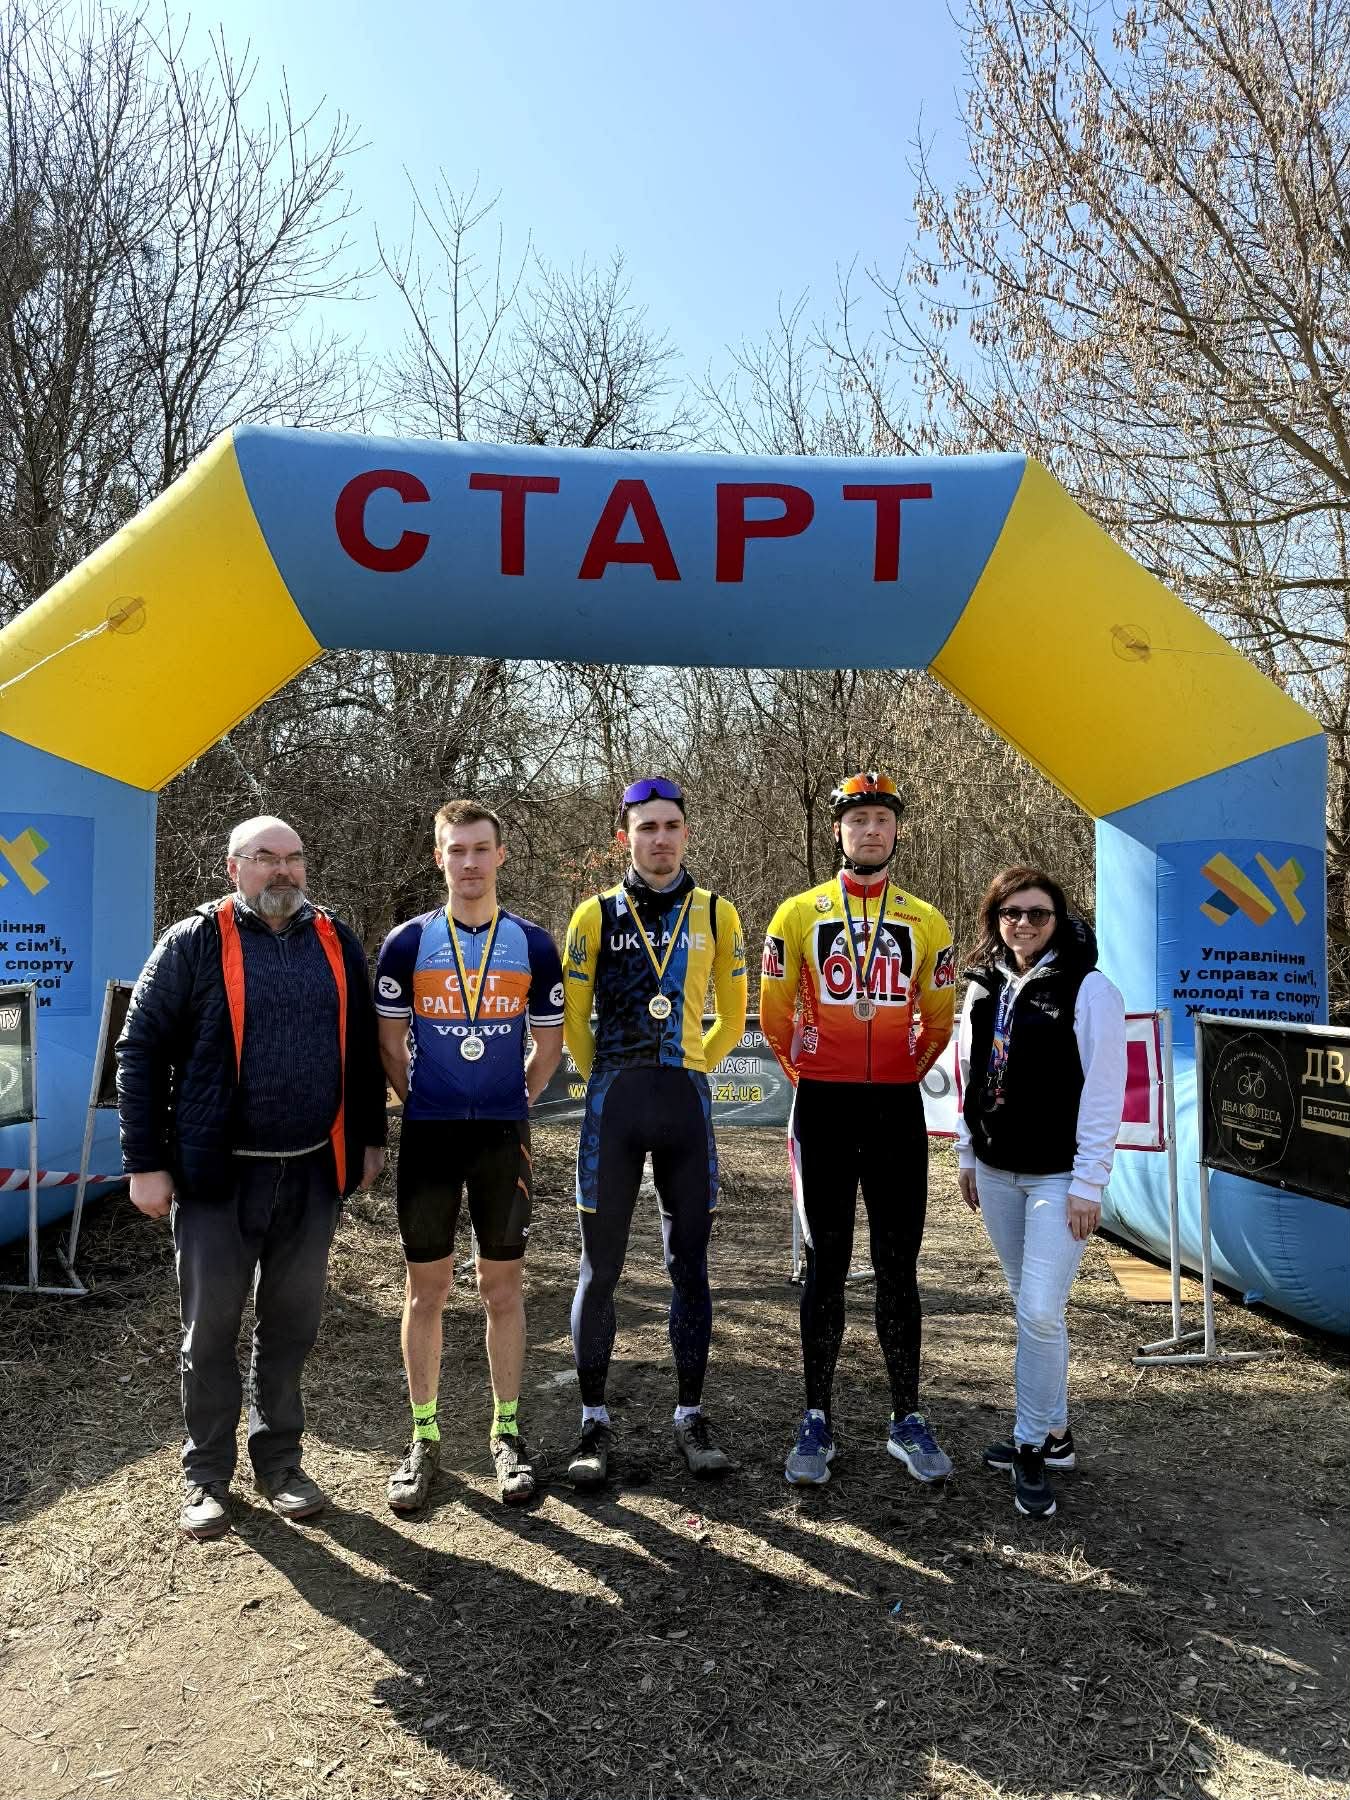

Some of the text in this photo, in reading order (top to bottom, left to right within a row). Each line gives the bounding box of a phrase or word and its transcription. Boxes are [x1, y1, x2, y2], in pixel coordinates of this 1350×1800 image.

[335, 469, 933, 583] СТАРТ
[0, 919, 46, 934] іння
[611, 931, 707, 952] UKRANE
[1201, 947, 1305, 966] Управління
[5, 959, 75, 974] спорту
[1179, 968, 1191, 984] у
[1197, 967, 1279, 984] справах
[422, 996, 521, 1014] PALYRA
[1173, 986, 1321, 1009] молоді та спорту
[0, 1007, 21, 1030] ТУ
[432, 1023, 513, 1037] VOLVO
[1302, 1047, 1350, 1087] ДВ
